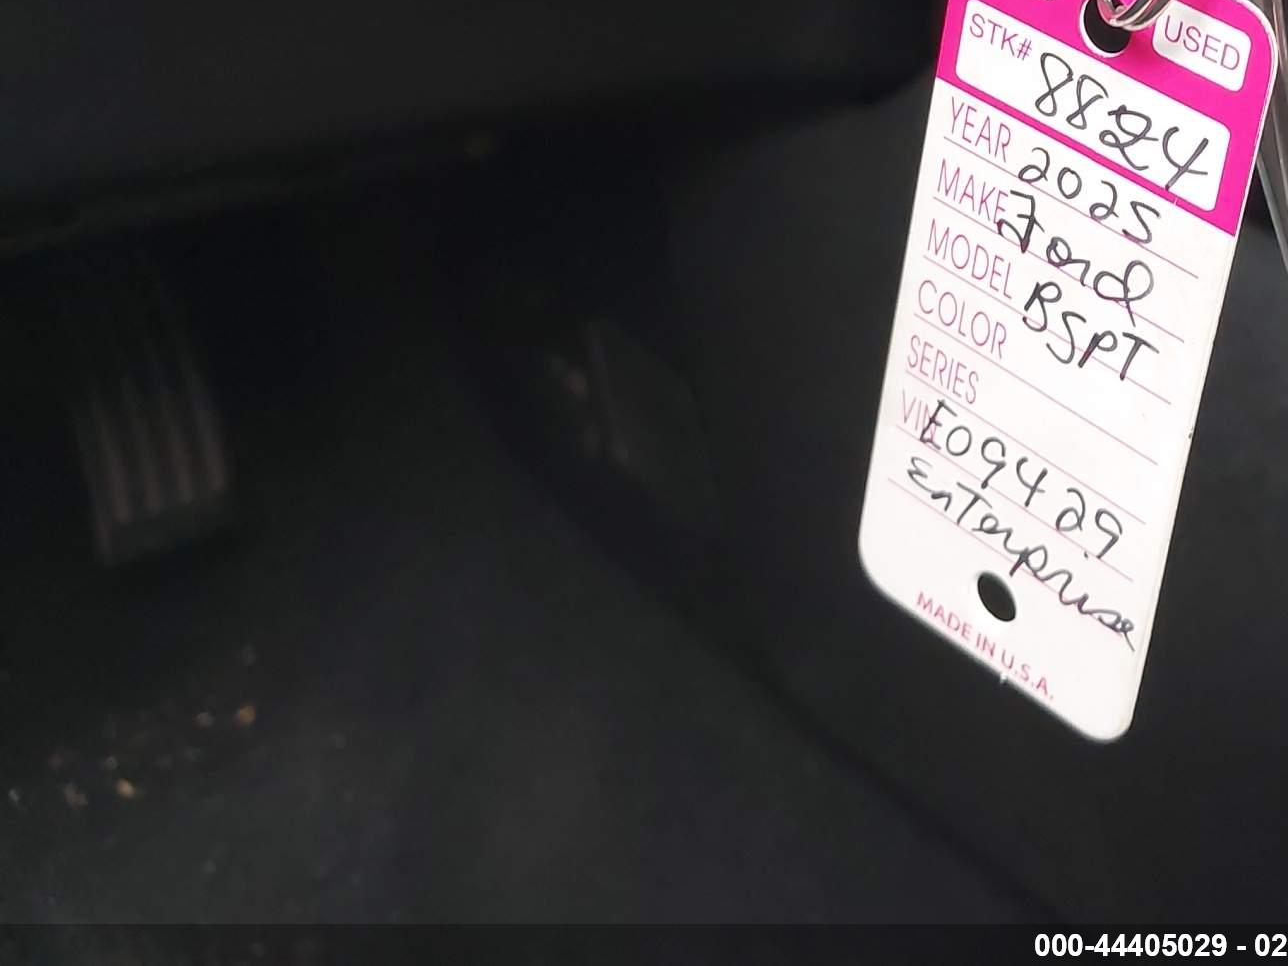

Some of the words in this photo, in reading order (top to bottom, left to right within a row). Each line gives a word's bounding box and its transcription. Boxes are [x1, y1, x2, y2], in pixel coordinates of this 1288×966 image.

[968, 12, 1034, 61] STK#
[1163, 15, 1241, 72] USED
[948, 95, 1011, 164] YEAR
[1034, 52, 1209, 191] 8824
[937, 158, 1009, 225] MAKE
[1018, 146, 1160, 245] 2025
[927, 218, 1013, 300] MODEL
[997, 189, 1155, 327] Ford
[918, 280, 1008, 360] COLOR
[907, 334, 979, 405] SERIES
[916, 591, 972, 642] MADE
[976, 633, 997, 659] IN
[1001, 649, 1055, 701] U.S.A.
